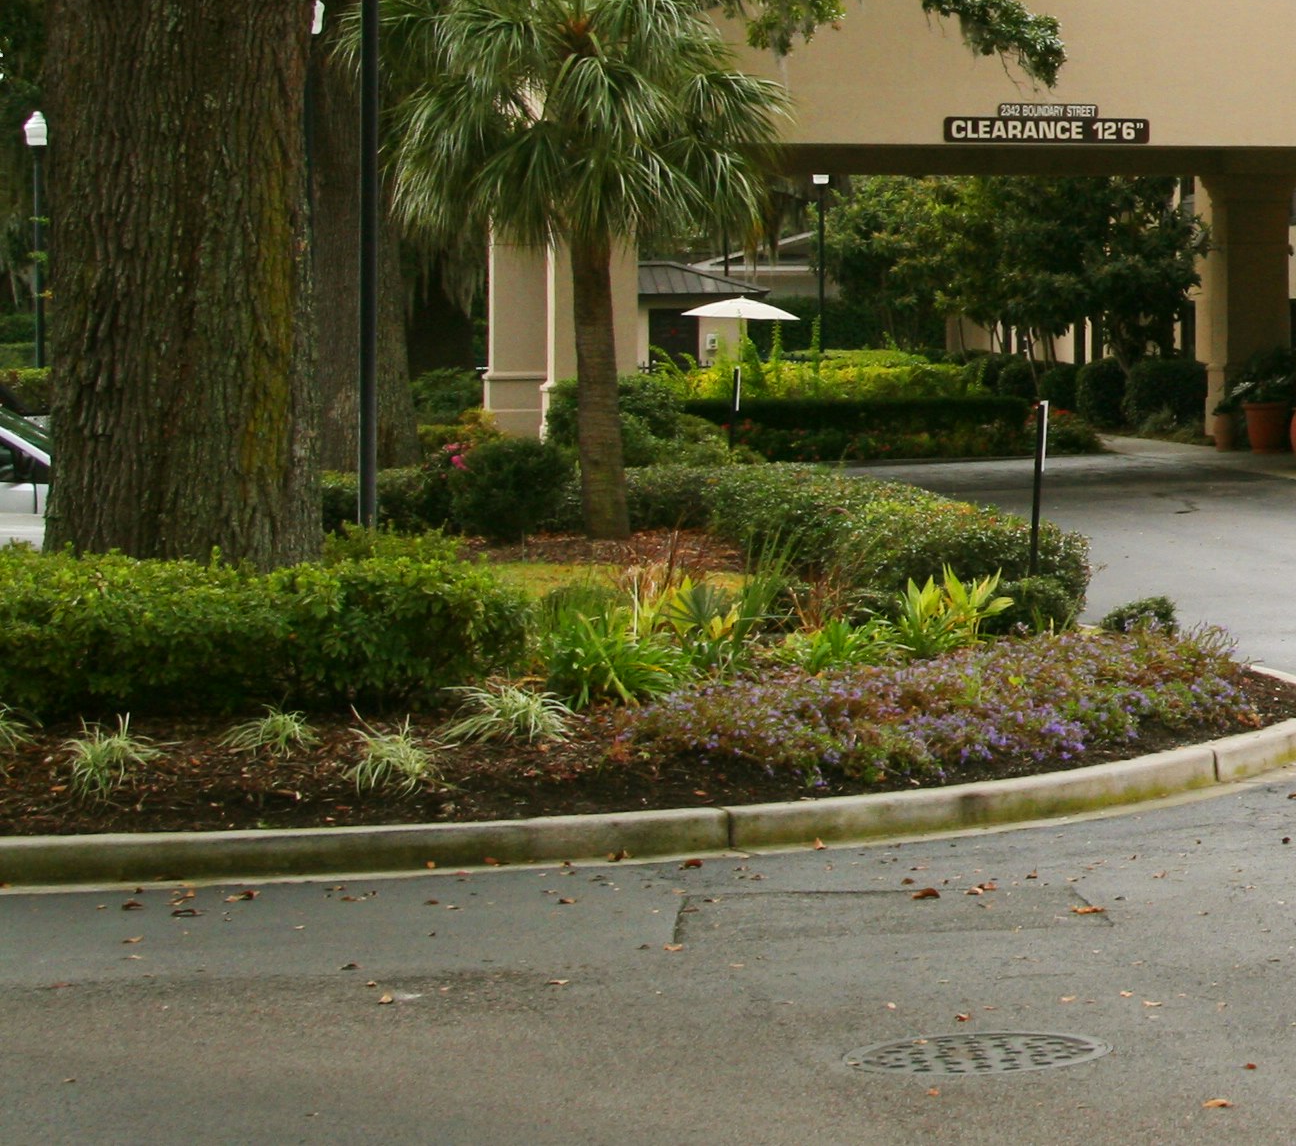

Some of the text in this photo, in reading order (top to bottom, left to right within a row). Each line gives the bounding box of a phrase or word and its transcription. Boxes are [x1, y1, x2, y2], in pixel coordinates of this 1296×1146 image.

[1001, 105, 1096, 117] 2342 BOUNDARY STREET
[951, 120, 1083, 140] CLEARANCE
